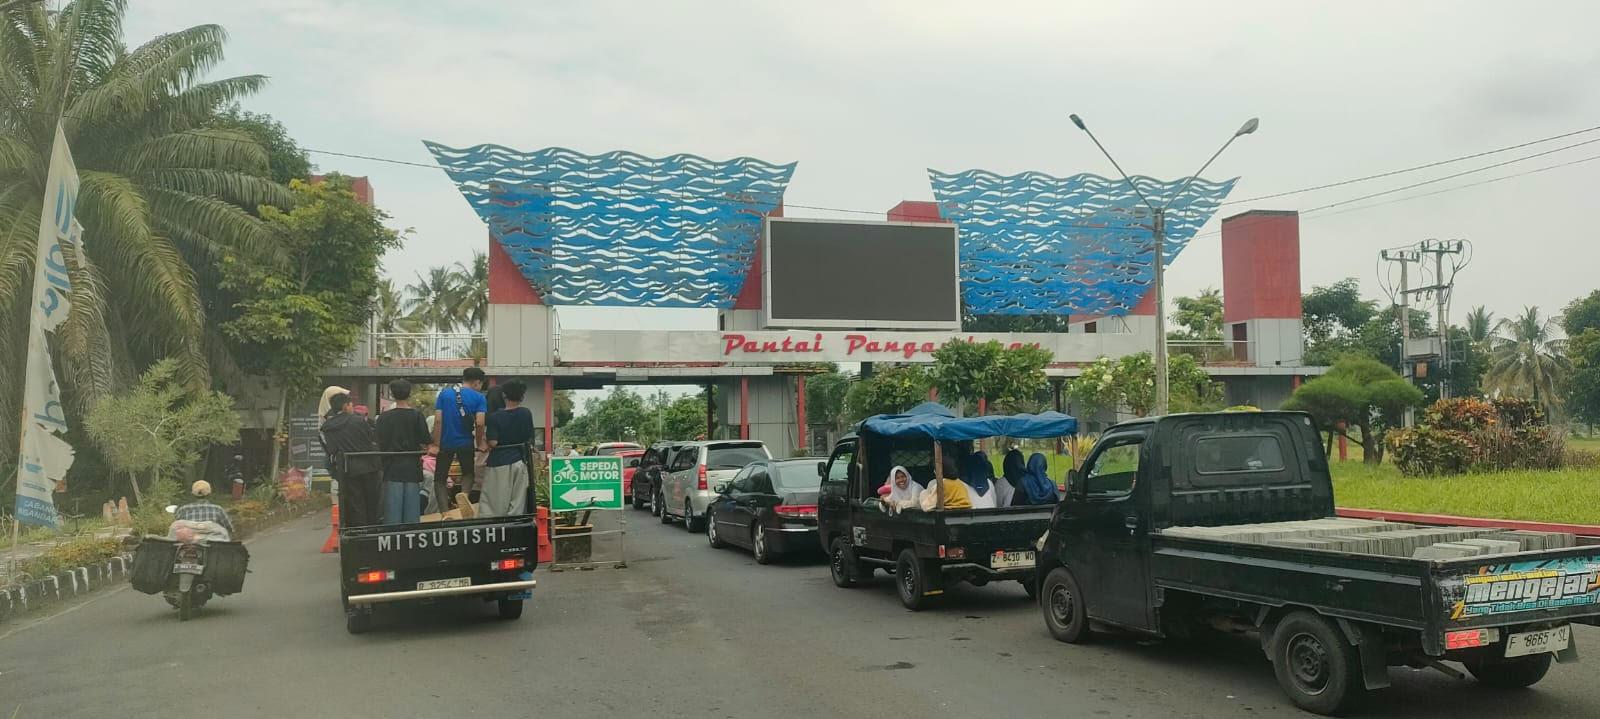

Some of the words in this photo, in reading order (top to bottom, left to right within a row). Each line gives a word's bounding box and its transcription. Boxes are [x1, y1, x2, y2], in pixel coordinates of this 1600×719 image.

[722, 333, 823, 355] Pantai
[580, 461, 619, 471] SEPEDA
[580, 471, 619, 481] MOTOR
[378, 527, 506, 552] MITSUBISHI
[1465, 572, 1597, 603] mengejar
[1509, 636, 1517, 648] F
[1525, 631, 1550, 647] 8665
[1558, 627, 1568, 642] SL
